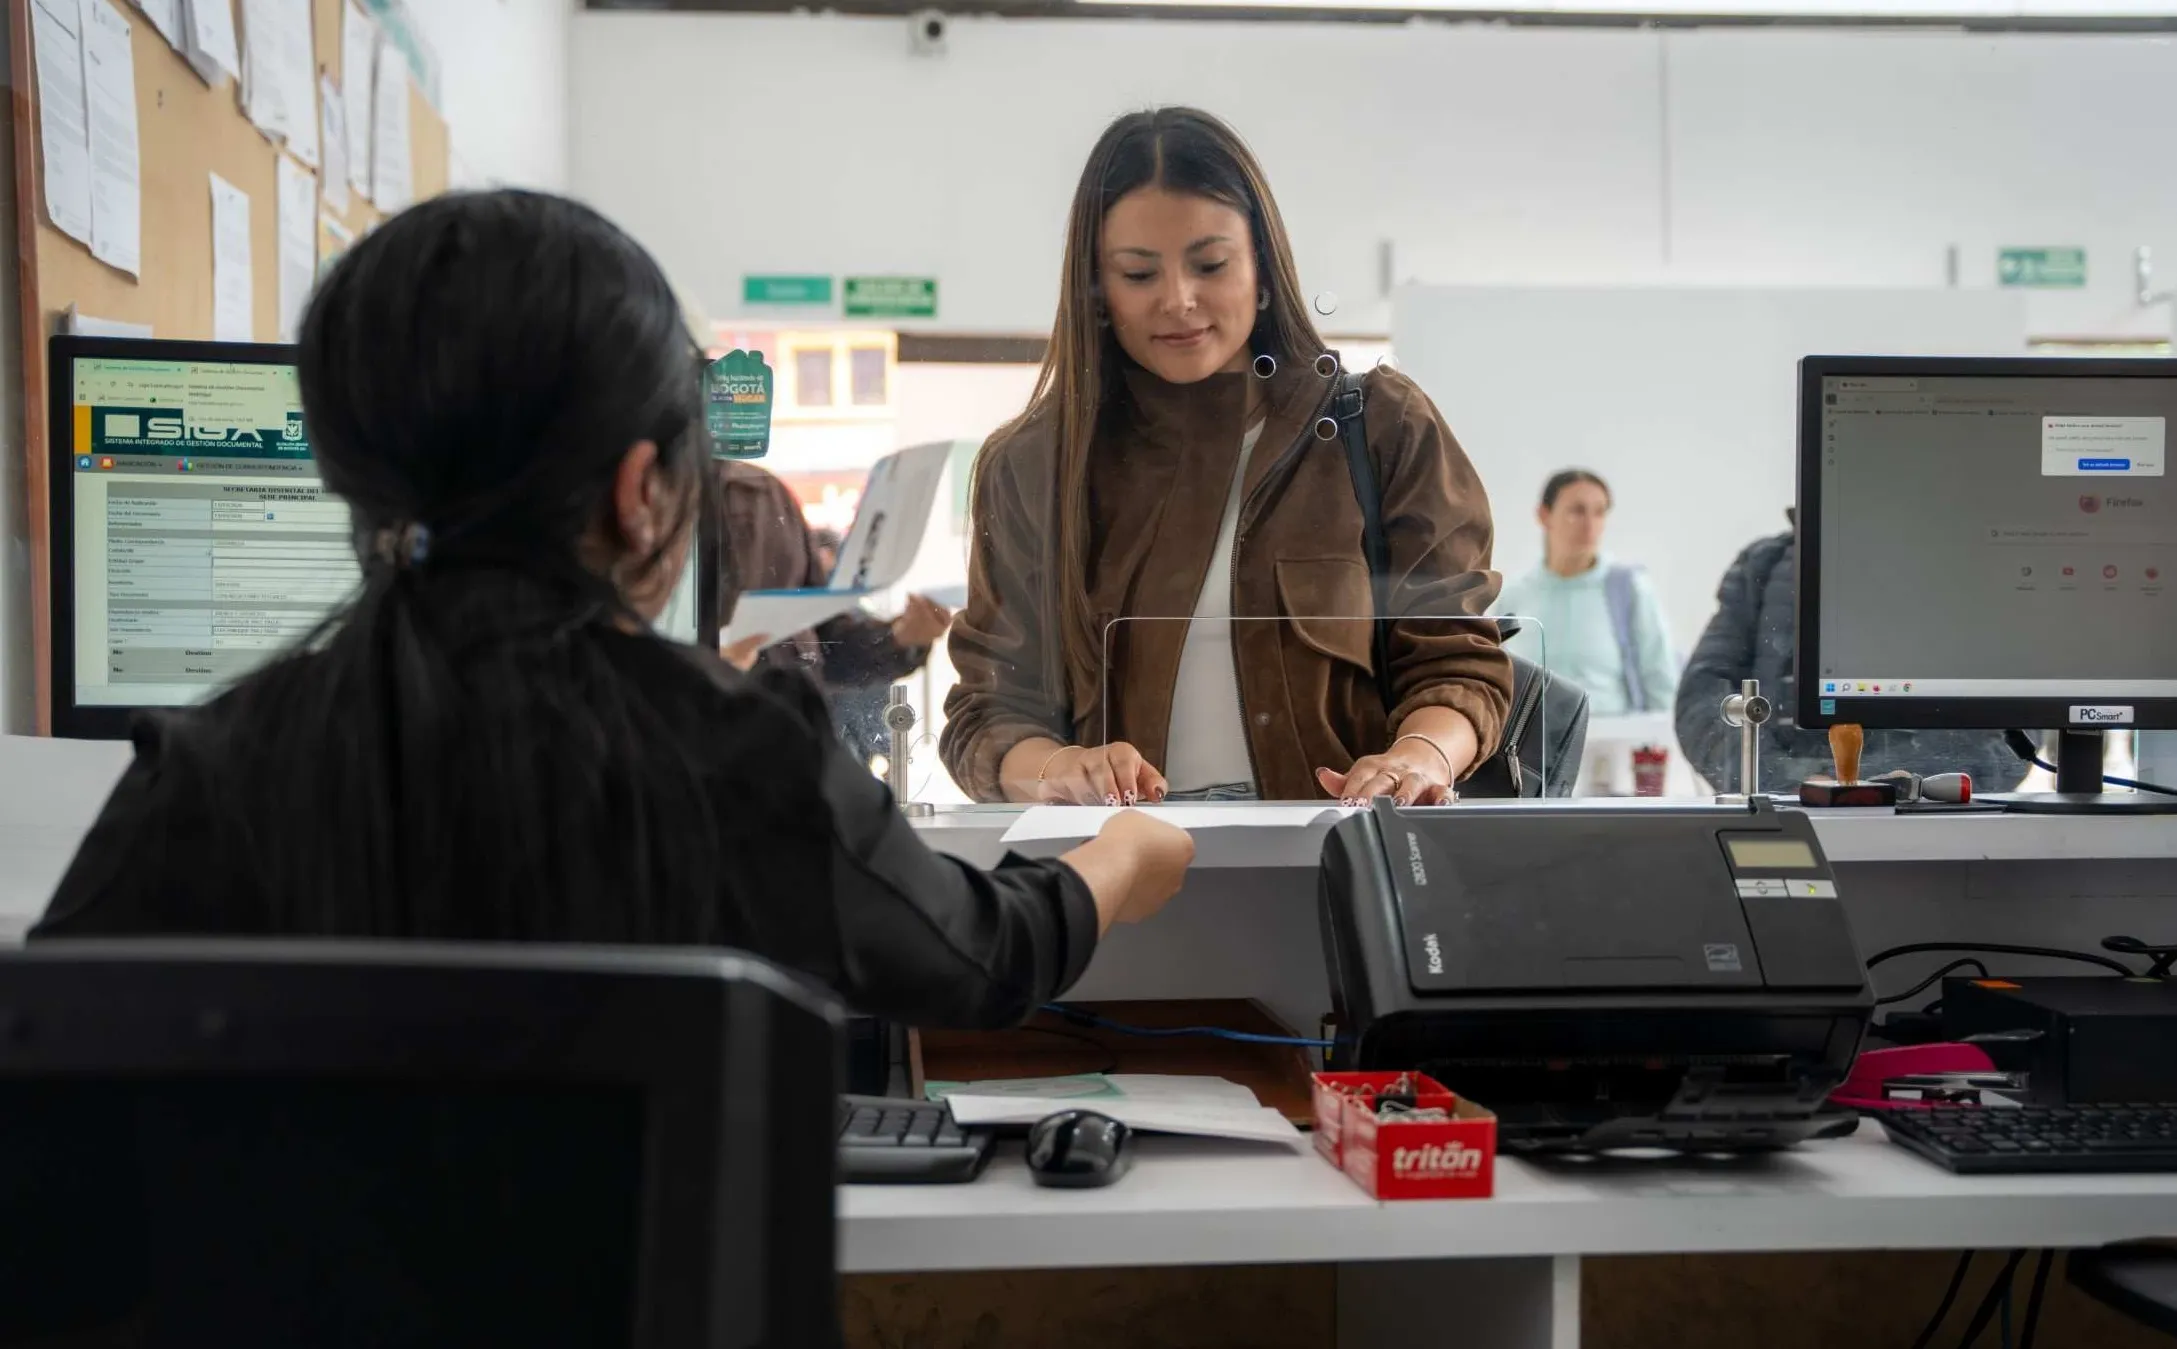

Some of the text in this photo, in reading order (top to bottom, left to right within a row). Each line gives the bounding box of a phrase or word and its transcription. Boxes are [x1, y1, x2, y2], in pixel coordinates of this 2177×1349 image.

[104, 437, 134, 446] SISTEMA
[135, 438, 174, 447] INTEGRADO
[217, 441, 264, 450] DOCUMENTAL
[2106, 497, 2144, 508] Firefox
[1406, 831, 1423, 861] Scanner
[1422, 933, 1444, 974] Kodak
